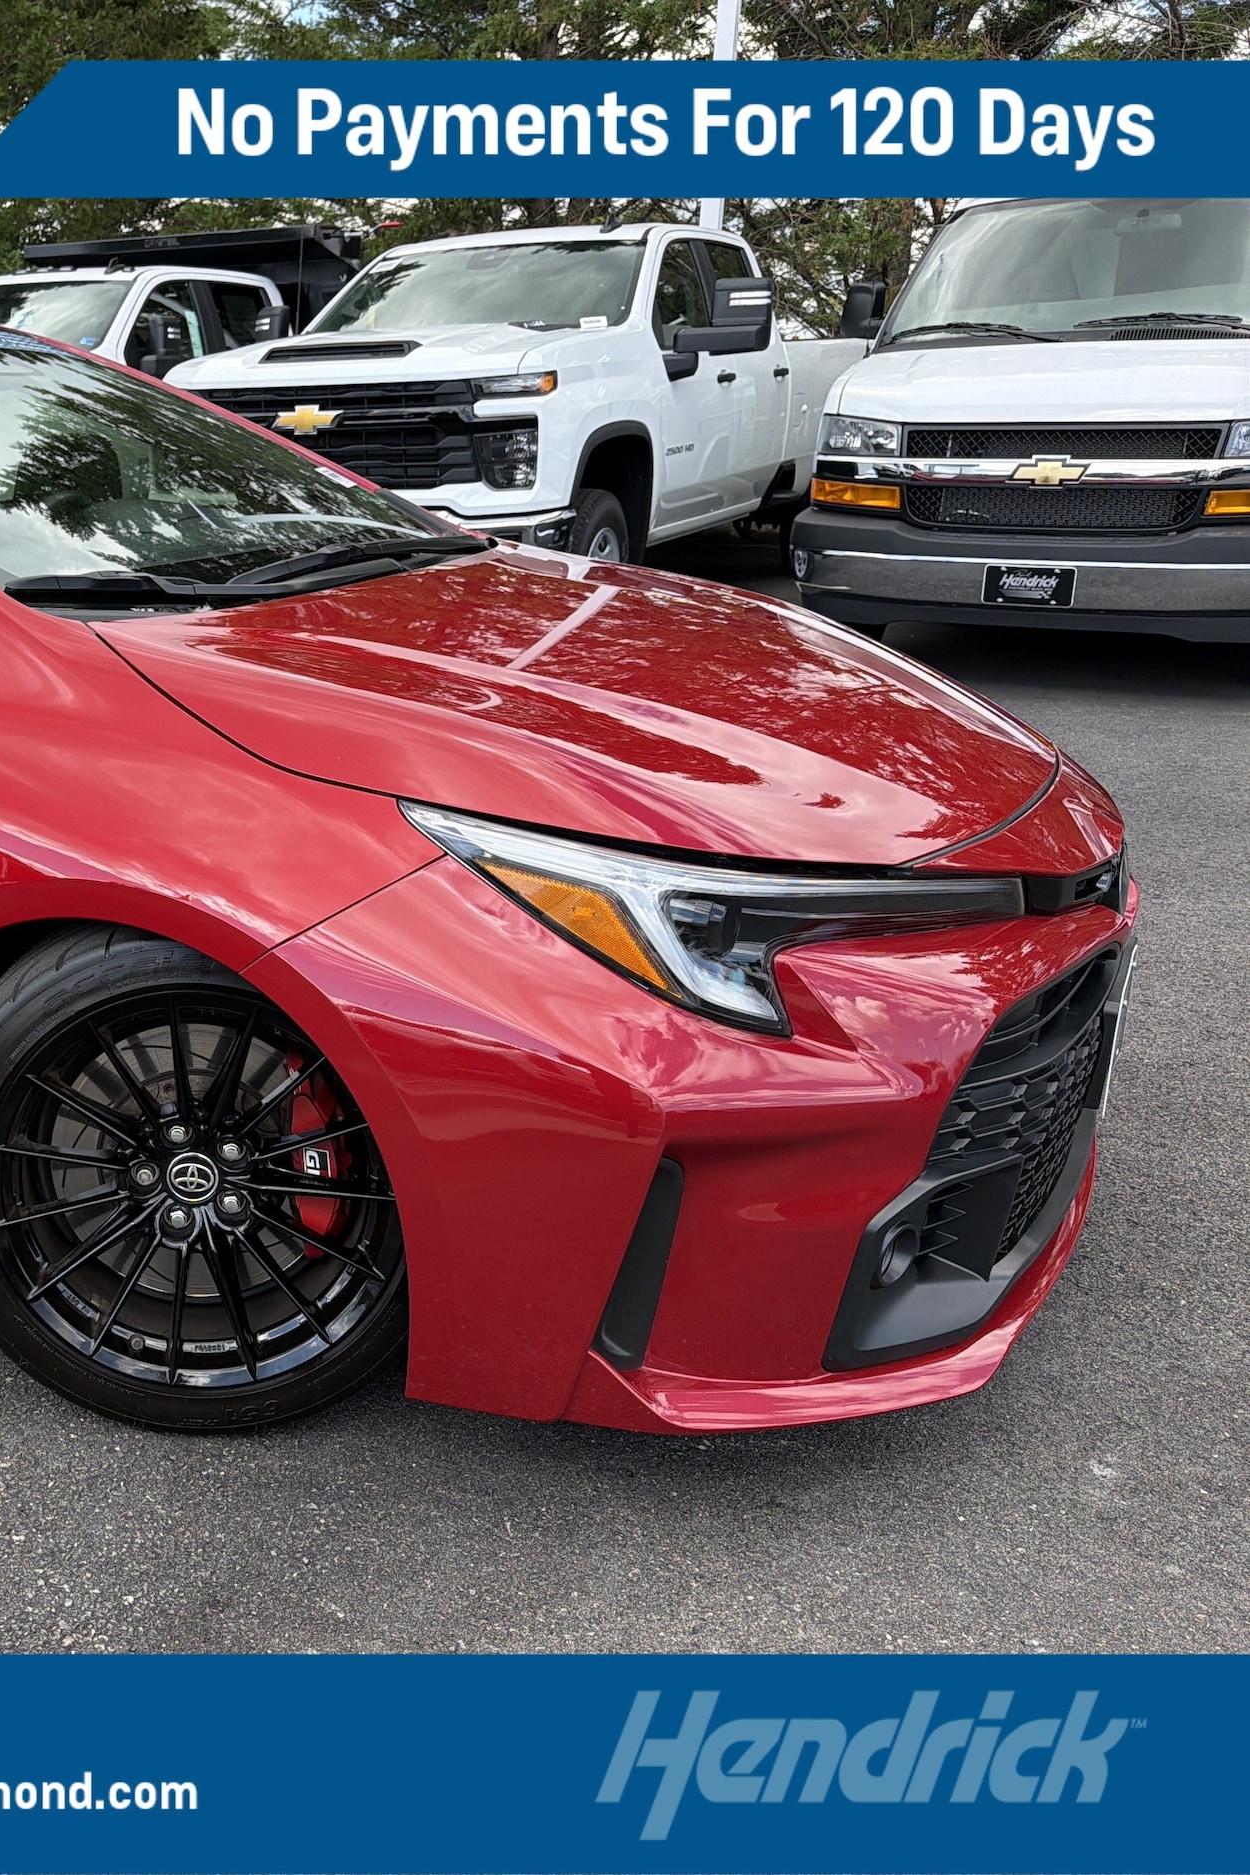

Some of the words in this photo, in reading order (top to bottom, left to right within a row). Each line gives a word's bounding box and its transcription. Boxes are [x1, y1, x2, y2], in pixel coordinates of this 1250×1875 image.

[665, 445, 684, 456] 2500
[684, 443, 695, 452] HD
[999, 573, 1059, 590] Hendrick
